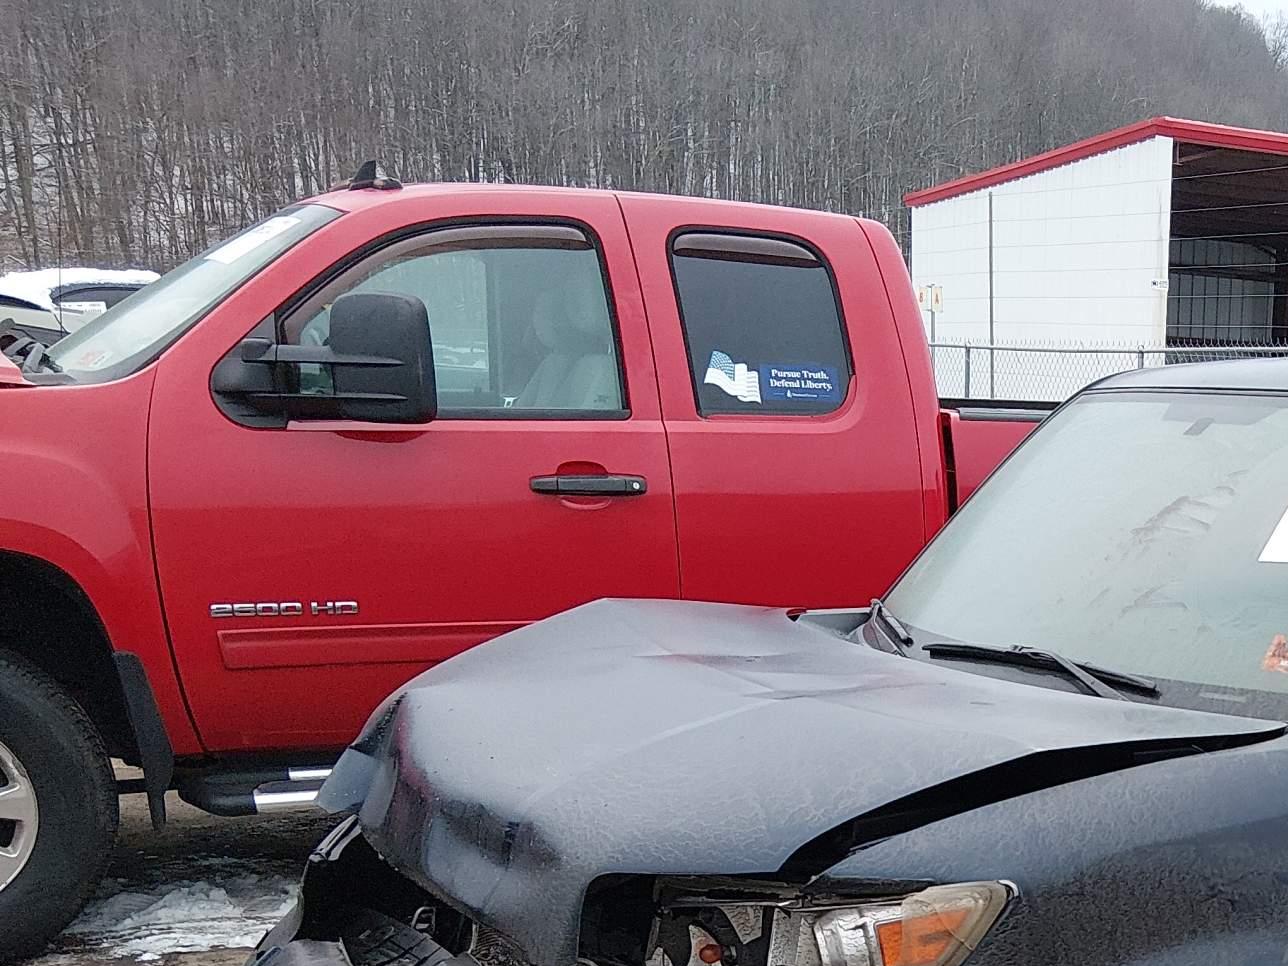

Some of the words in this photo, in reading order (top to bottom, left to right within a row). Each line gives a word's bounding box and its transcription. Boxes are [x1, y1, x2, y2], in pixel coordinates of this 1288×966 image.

[771, 369, 801, 378] Pursue
[801, 370, 829, 380] Truth.
[769, 378, 800, 388] Defend
[210, 603, 302, 617] 2500
[311, 601, 358, 615] HD
